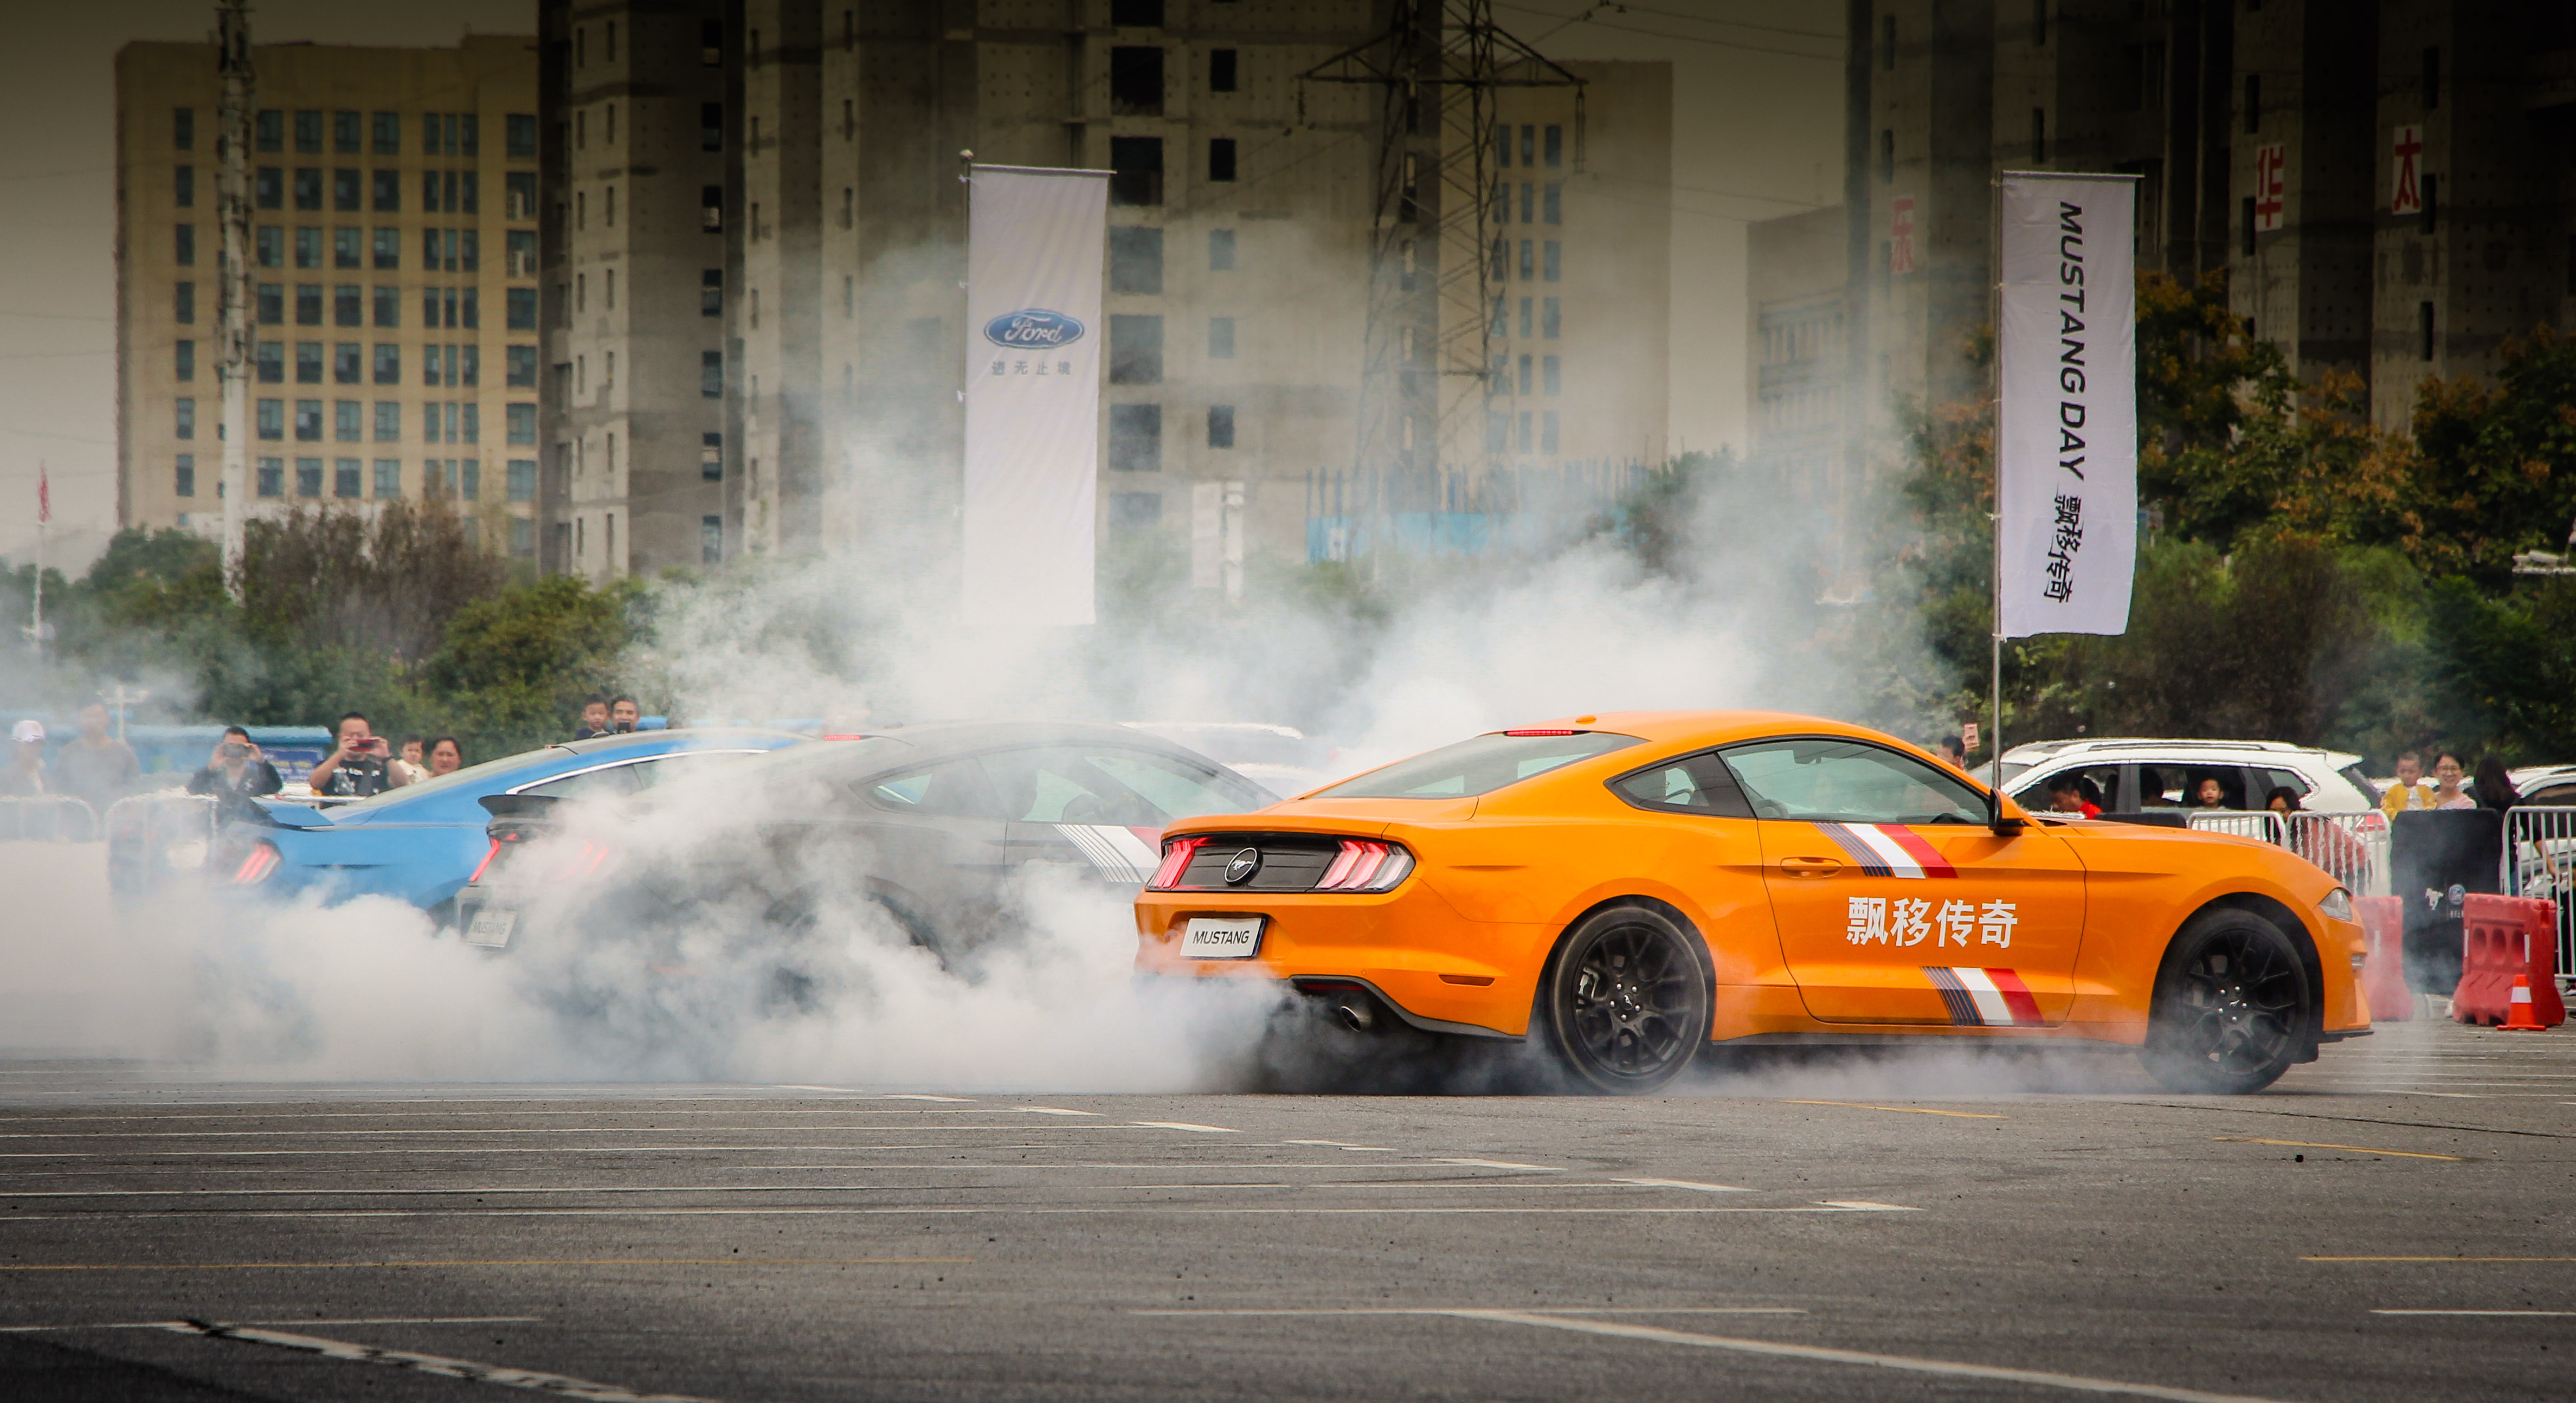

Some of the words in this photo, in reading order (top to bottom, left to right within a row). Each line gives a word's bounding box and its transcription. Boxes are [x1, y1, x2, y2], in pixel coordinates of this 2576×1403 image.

[2256, 145, 2284, 228] 华
[2394, 128, 2421, 211] 太
[1004, 314, 1064, 343] Ford
[2059, 201, 2086, 394] MUSTANG
[2059, 401, 2086, 481] DAY
[2044, 482, 2084, 603] 飘移传奇
[1193, 930, 1250, 944] MUSTANG
[1846, 896, 2018, 948] 飘移传奇
